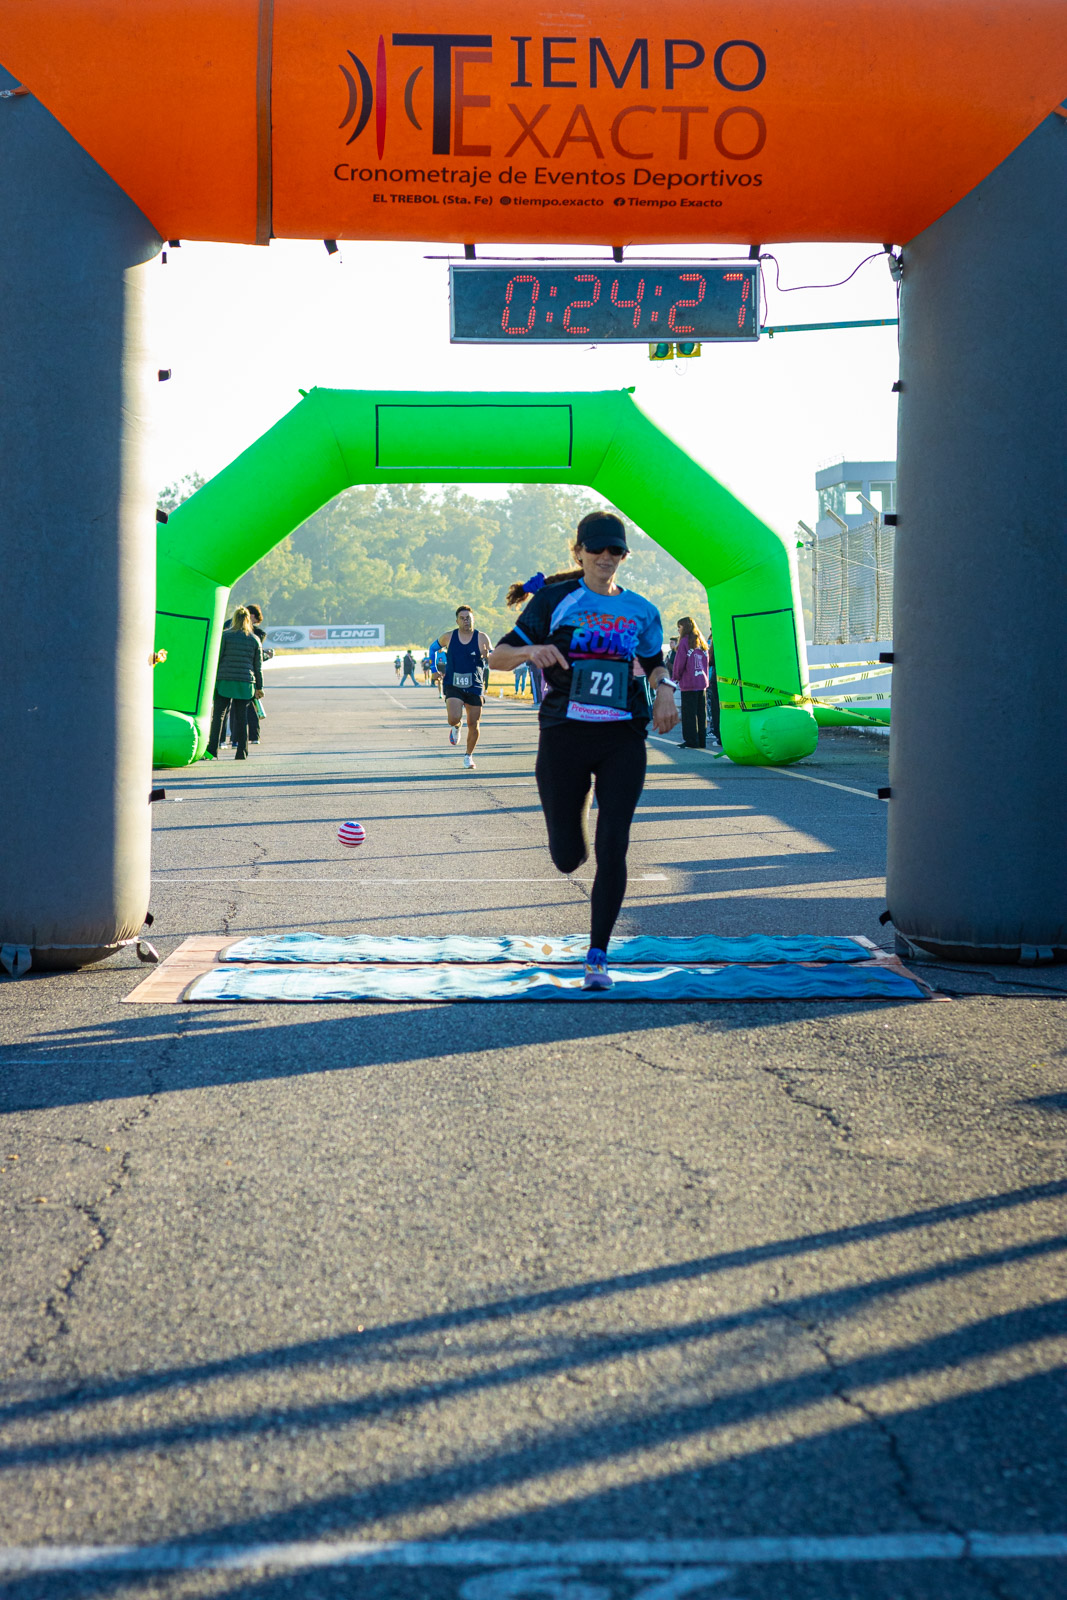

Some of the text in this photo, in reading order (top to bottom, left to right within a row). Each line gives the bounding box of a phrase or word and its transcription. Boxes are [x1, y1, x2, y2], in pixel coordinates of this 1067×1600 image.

[333, 163, 763, 190] Cronometraje de Eventos Deportivos
[372, 194, 723, 208] EL TREBOL (Sta. Fe) tiempo.exacto Tiempo Exacto
[501, 273, 750, 335] 0:24:27
[272, 631, 297, 642] Ford
[330, 630, 376, 638] LONG
[456, 677, 469, 686] 149
[589, 671, 615, 698] 72
